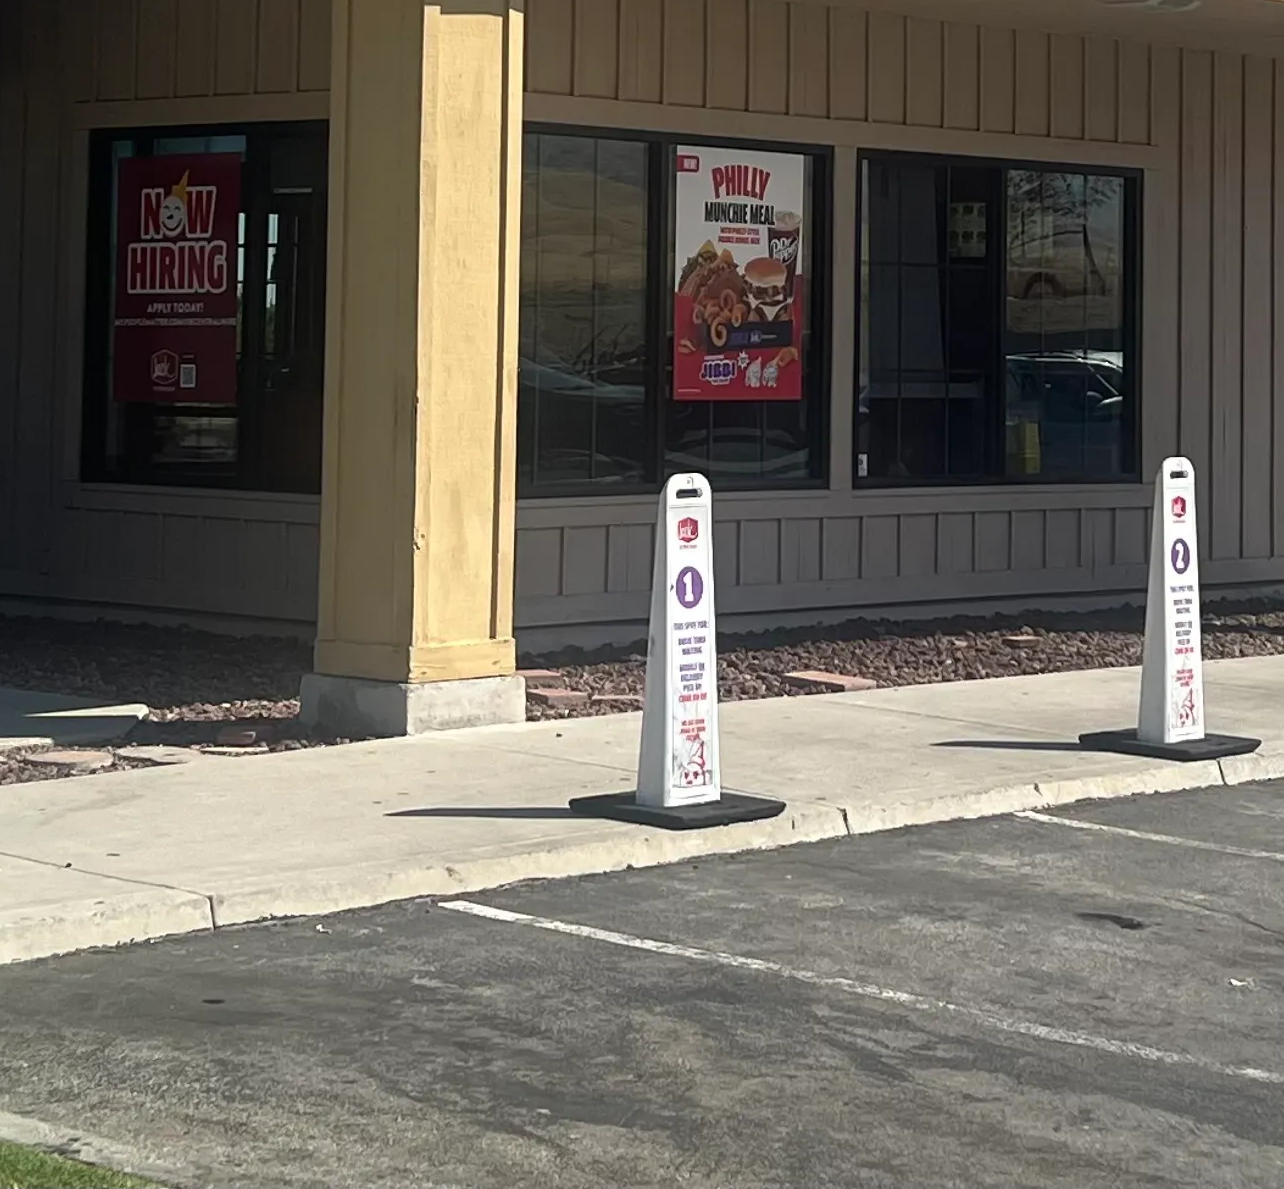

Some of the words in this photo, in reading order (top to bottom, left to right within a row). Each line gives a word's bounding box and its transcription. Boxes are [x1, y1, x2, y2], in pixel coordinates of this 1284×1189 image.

[711, 164, 771, 202] PHILLY
[704, 201, 748, 225] MUNCHIE
[749, 203, 776, 226] MEAL
[127, 240, 228, 295] HIRING
[1175, 542, 1185, 569] 2
[683, 571, 695, 602] 1
